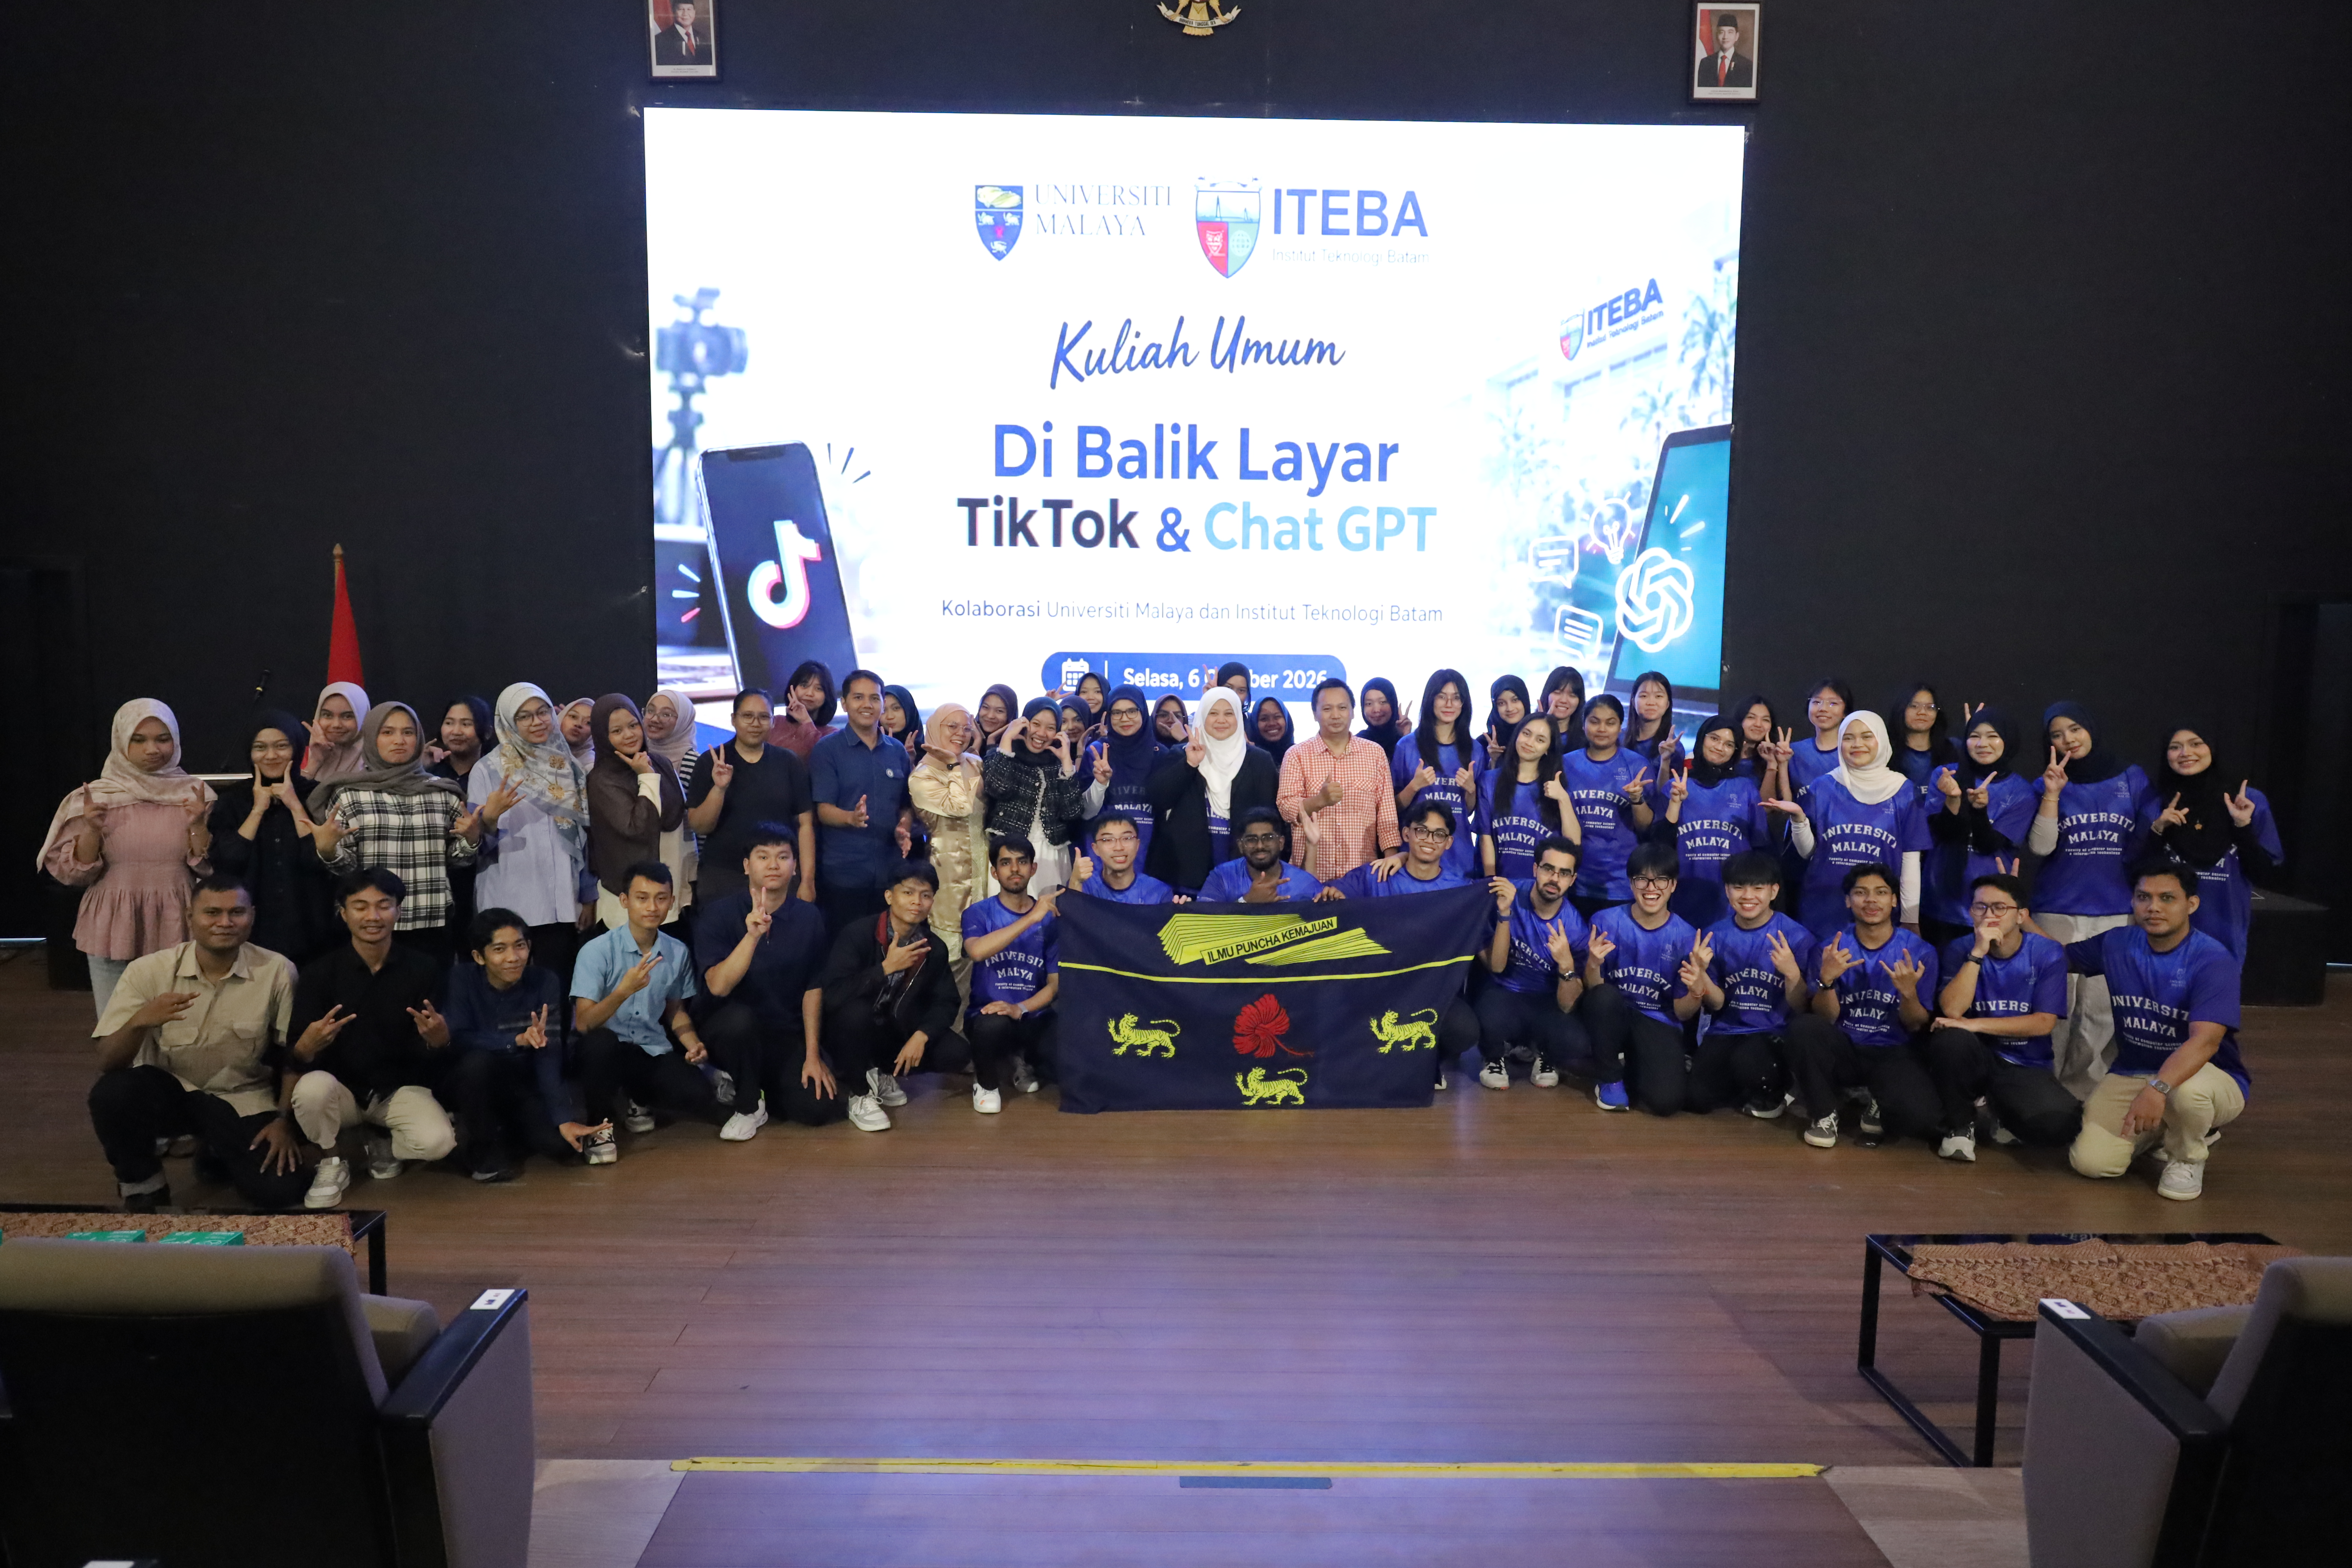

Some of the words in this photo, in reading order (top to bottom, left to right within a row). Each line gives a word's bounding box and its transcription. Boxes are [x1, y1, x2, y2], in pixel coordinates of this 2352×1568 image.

[1035, 184, 1171, 205] UNIVERSITI
[1274, 188, 1429, 237] ITEBA
[1037, 213, 1145, 236] MALAYA
[1273, 248, 1315, 262] Institut
[1321, 249, 1383, 266] Teknologi
[1387, 250, 1429, 263] Batam
[1587, 277, 1663, 335] ITEBA
[1050, 315, 1200, 390] Kuliah
[1211, 315, 1346, 373] Umum
[994, 420, 1053, 478] Di
[1076, 422, 1219, 480] Balik
[1239, 427, 1399, 498] Layar
[956, 495, 1140, 549] TikTok
[1156, 507, 1192, 553] &
[1204, 501, 1324, 551] Chat
[1336, 506, 1438, 552] GPT
[942, 599, 1040, 616] Kolaborasi
[1047, 601, 1129, 618] Universiti
[1136, 602, 1193, 623] Malaya
[1199, 603, 1230, 619] dan
[1236, 603, 1295, 620] Institut
[1302, 604, 1384, 626] Teknologi
[1390, 605, 1443, 622] Batam
[1123, 668, 1184, 690] Selasa,
[1188, 669, 1200, 688] 6
[1282, 669, 1327, 689] 2026
[1114, 803, 1152, 814] MALAYA
[1573, 789, 1629, 808] IVERSIT
[1492, 816, 1553, 838] NIVERSITI
[1677, 819, 1742, 841] NIVERSIT
[2068, 830, 2119, 844] MALAYA
[1497, 832, 1536, 846] MALAYA
[1685, 836, 1730, 849] MALAYA
[1832, 841, 1881, 857] MALAYA
[1207, 946, 1234, 963] ILMU
[1236, 934, 1281, 955] PUNCHA
[1282, 919, 1334, 942] KEMAJUAN
[997, 967, 1033, 981] MALYA
[1608, 966, 1672, 991] UNIVERSTI
[1618, 983, 1660, 1000] MALAYA
[1735, 985, 1768, 1000] ALAYA
[1849, 1008, 1886, 1020] MALAY
[2123, 1017, 2176, 1037] MALAYA
